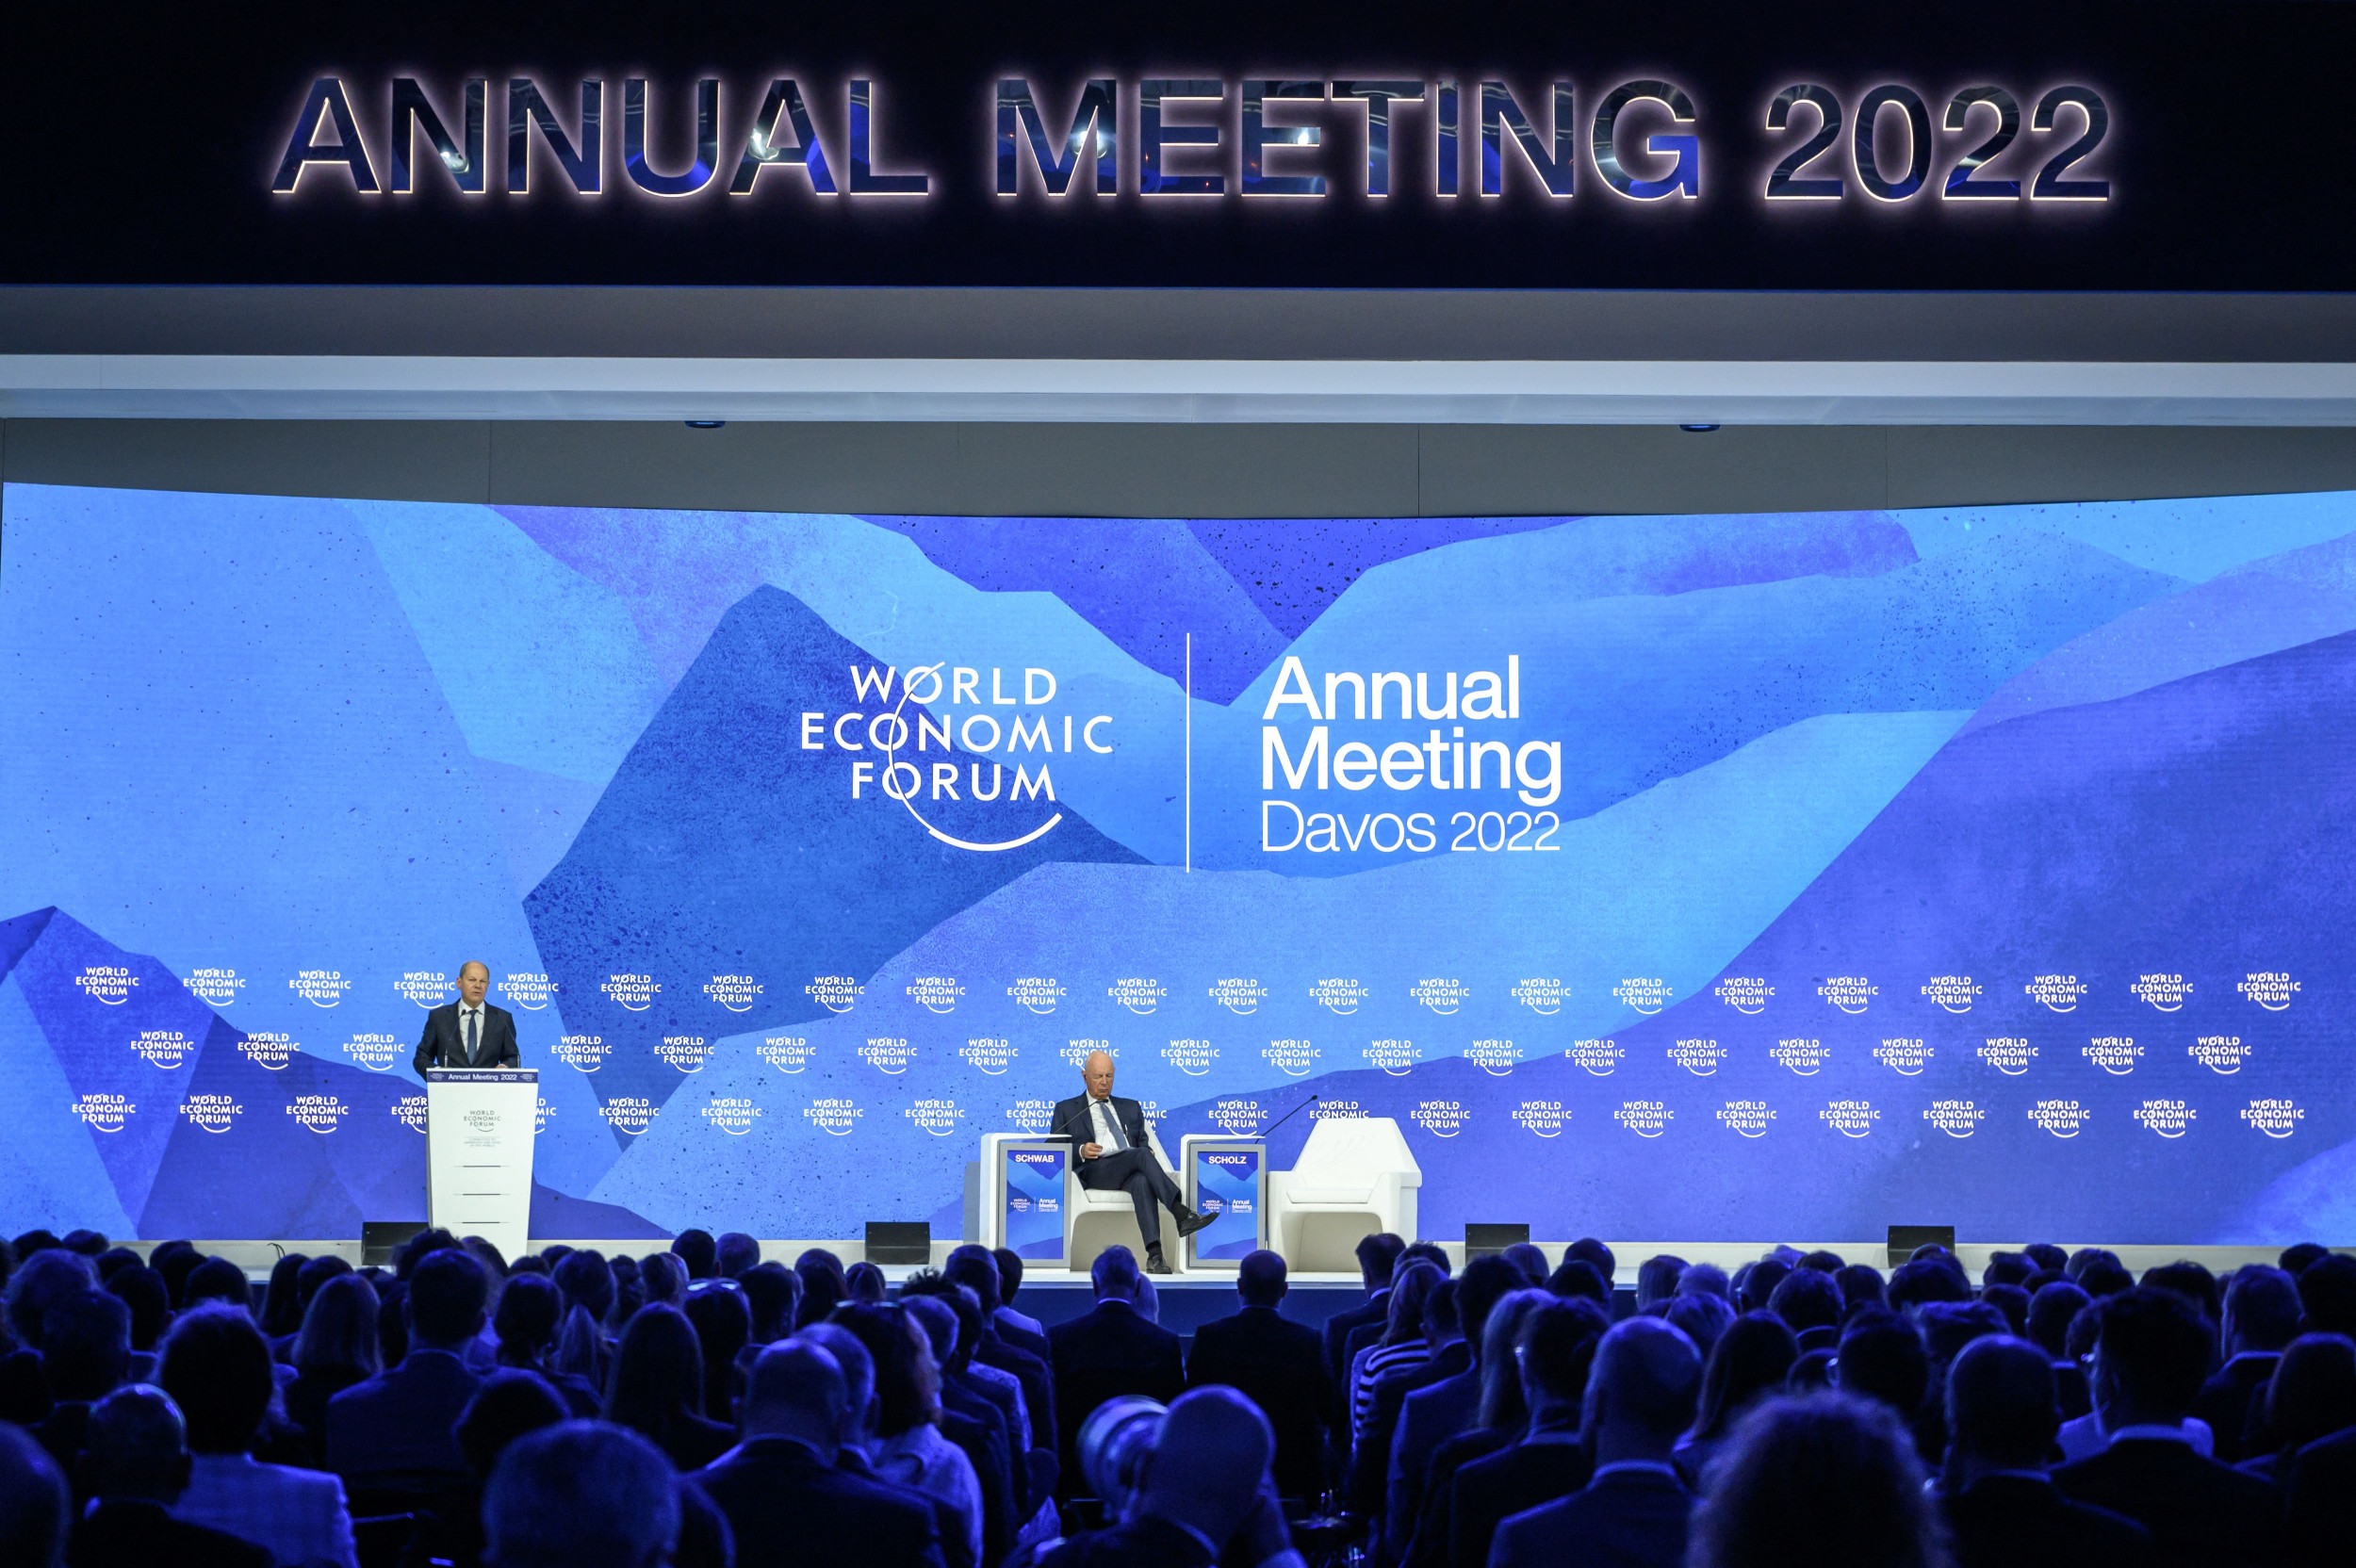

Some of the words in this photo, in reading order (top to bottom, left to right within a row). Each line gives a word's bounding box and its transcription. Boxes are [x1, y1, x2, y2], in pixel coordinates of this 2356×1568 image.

[271, 77, 929, 196] ANNUAL
[996, 78, 1698, 200] MEETING
[1764, 84, 2110, 202] 2022
[849, 664, 1057, 706] WORLD
[1262, 654, 1520, 720] Annual
[801, 711, 1114, 754] ECONOMIC
[1262, 726, 1562, 807] Meeting
[851, 761, 1056, 801] FORUM
[1262, 800, 1437, 853] Davos
[1450, 810, 1561, 852] 2022
[86, 967, 129, 977] WORLD
[299, 970, 341, 980] WORLD
[403, 972, 445, 982] WORLD
[75, 976, 139, 987] ECONOMIC
[507, 973, 548, 983] WORLD
[712, 975, 753, 985] WORLD
[814, 976, 855, 986] WORLD
[1724, 977, 1765, 988] WORLD
[1826, 977, 1868, 987] WORLD
[2034, 974, 2077, 985] WORLD
[2139, 973, 2183, 984] WORLD
[2246, 972, 2290, 983] WORLD
[288, 979, 352, 989] ECONOMIC
[393, 981, 456, 991] ECONOMIC
[498, 982, 559, 992] ECONOMIC
[1016, 978, 1056, 988] WORLD
[1117, 978, 1157, 988] WORLD
[1317, 978, 1359, 988] WORLD
[1418, 978, 1460, 988] WORLD
[1520, 978, 1561, 988] WORLD
[2130, 983, 2194, 993] ECONOMIC
[2237, 981, 2301, 992] ECONOMIC
[85, 986, 128, 996] FORUM
[299, 988, 340, 999] FORUM
[703, 984, 763, 994] ECONOMIC
[805, 985, 865, 995] ECONOMIC
[1006, 987, 1067, 996] ECONOMIC
[1107, 987, 1168, 997] ECONOMIC
[1309, 988, 1369, 997] ECONOMIC
[1410, 988, 1470, 997] ECONOMIC
[1511, 987, 1571, 997] ECONOMIC
[1714, 987, 1775, 996] ECONOMIC
[1817, 986, 1879, 996] ECONOMIC
[2025, 984, 2087, 994] ECONOMIC
[403, 990, 445, 1001] FORUM
[507, 991, 548, 1002] FORUM
[712, 993, 753, 1003] FORUM
[814, 994, 855, 1004] FORUM
[1016, 996, 1056, 1005] FORUM
[1117, 996, 1157, 1005] FORUM
[1725, 996, 1765, 1005] FORUM
[1827, 995, 1869, 1005] FORUM
[2035, 993, 2077, 1004] FORUM
[2140, 992, 2183, 1003] FORUM
[2247, 991, 2290, 1002] FORUM
[1318, 996, 1358, 1006] FORUM
[1419, 997, 1460, 1006] FORUM
[1520, 996, 1561, 1006] FORUM
[247, 1032, 290, 1042] WORLD
[352, 1034, 395, 1043] WORLD
[663, 1037, 704, 1046] WORLD
[765, 1037, 807, 1047] WORLD
[2197, 1036, 2240, 1046] WORLD
[237, 1041, 300, 1052] ECONOMIC
[342, 1042, 405, 1053] ECONOMIC
[866, 1037, 908, 1048] WORLD
[1170, 1039, 1210, 1049] WORLD
[1270, 1039, 1311, 1049] WORLD
[1472, 1039, 1513, 1049] WORLD
[1574, 1039, 1615, 1049] WORLD
[1778, 1038, 1820, 1049] WORLD
[1882, 1038, 1923, 1048] WORLD
[1986, 1037, 2028, 1048] WORLD
[653, 1045, 714, 1055] ECONOMIC
[756, 1046, 814, 1056] ECONOMIC
[858, 1047, 918, 1056] ECONOMIC
[1160, 1048, 1220, 1058] ECONOMIC
[1261, 1048, 1321, 1058] ECONOMIC
[1463, 1049, 1524, 1058] ECONOMIC
[1564, 1048, 1626, 1058] ECONOMIC
[1769, 1048, 1831, 1058] ECONOMIC
[1873, 1047, 1935, 1057] ECONOMIC
[1976, 1047, 2039, 1057] ECONOMIC
[2187, 1045, 2251, 1056] ECONOMIC
[247, 1051, 289, 1061] FORUM
[352, 1052, 394, 1062] FORUM
[663, 1054, 704, 1064] FORUM
[765, 1055, 806, 1065] FORUM
[867, 1055, 908, 1066] FORUM
[2198, 1055, 2241, 1066] FORUM
[1170, 1057, 1210, 1067] FORUM
[1270, 1057, 1311, 1067] FORUM
[1473, 1057, 1513, 1068] FORUM
[1575, 1057, 1615, 1068] FORUM
[1779, 1057, 1820, 1067] FORUM
[1882, 1056, 1923, 1067] FORUM
[1987, 1056, 2028, 1067] FORUM
[472, 1073, 499, 1082] Meeting
[82, 1094, 125, 1104] WORLD
[296, 1096, 338, 1106] WORLD
[608, 1098, 649, 1107] WORLD
[711, 1098, 752, 1108] WORLD
[72, 1103, 137, 1114] ECONOMIC
[914, 1100, 955, 1109] WORLD
[1218, 1101, 1258, 1110] WORLD
[1318, 1101, 1359, 1110] WORLD
[1521, 1101, 1562, 1110] WORLD
[1623, 1101, 1664, 1111] WORLD
[1828, 1101, 1870, 1110] WORLD
[1932, 1101, 1974, 1110] WORLD
[2037, 1100, 2079, 1110] WORLD
[2250, 1100, 2293, 1110] WORLD
[286, 1105, 349, 1116] ECONOMIC
[598, 1107, 660, 1117] ECONOMIC
[701, 1107, 761, 1118] ECONOMIC
[905, 1108, 965, 1119] ECONOMIC
[1208, 1110, 1268, 1119] ECONOMIC
[1309, 1110, 1369, 1119] ECONOMIC
[1512, 1110, 1572, 1119] ECONOMIC
[1613, 1110, 1675, 1119] ECONOMIC
[1819, 1110, 1881, 1119] ECONOMIC
[1922, 1109, 1986, 1119] ECONOMIC
[2027, 1109, 2090, 1119] ECONOMIC
[2240, 1109, 2305, 1119] ECONOMIC
[81, 1113, 124, 1123] FORUM
[296, 1115, 337, 1124] FORUM
[608, 1117, 649, 1126] FORUM
[711, 1117, 751, 1126] FORUM
[914, 1118, 955, 1127] FORUM
[1218, 1119, 1257, 1128] FORUM
[1521, 1119, 1562, 1129] FORUM
[1623, 1119, 1664, 1129] FORUM
[1829, 1119, 1871, 1129] FORUM
[1933, 1119, 1974, 1129] FORUM
[2037, 1119, 2080, 1129] FORUM
[2250, 1119, 2294, 1129] FORUM
[1015, 1154, 1055, 1163] SCHWAB
[1208, 1156, 1247, 1165] SCHOLZ
